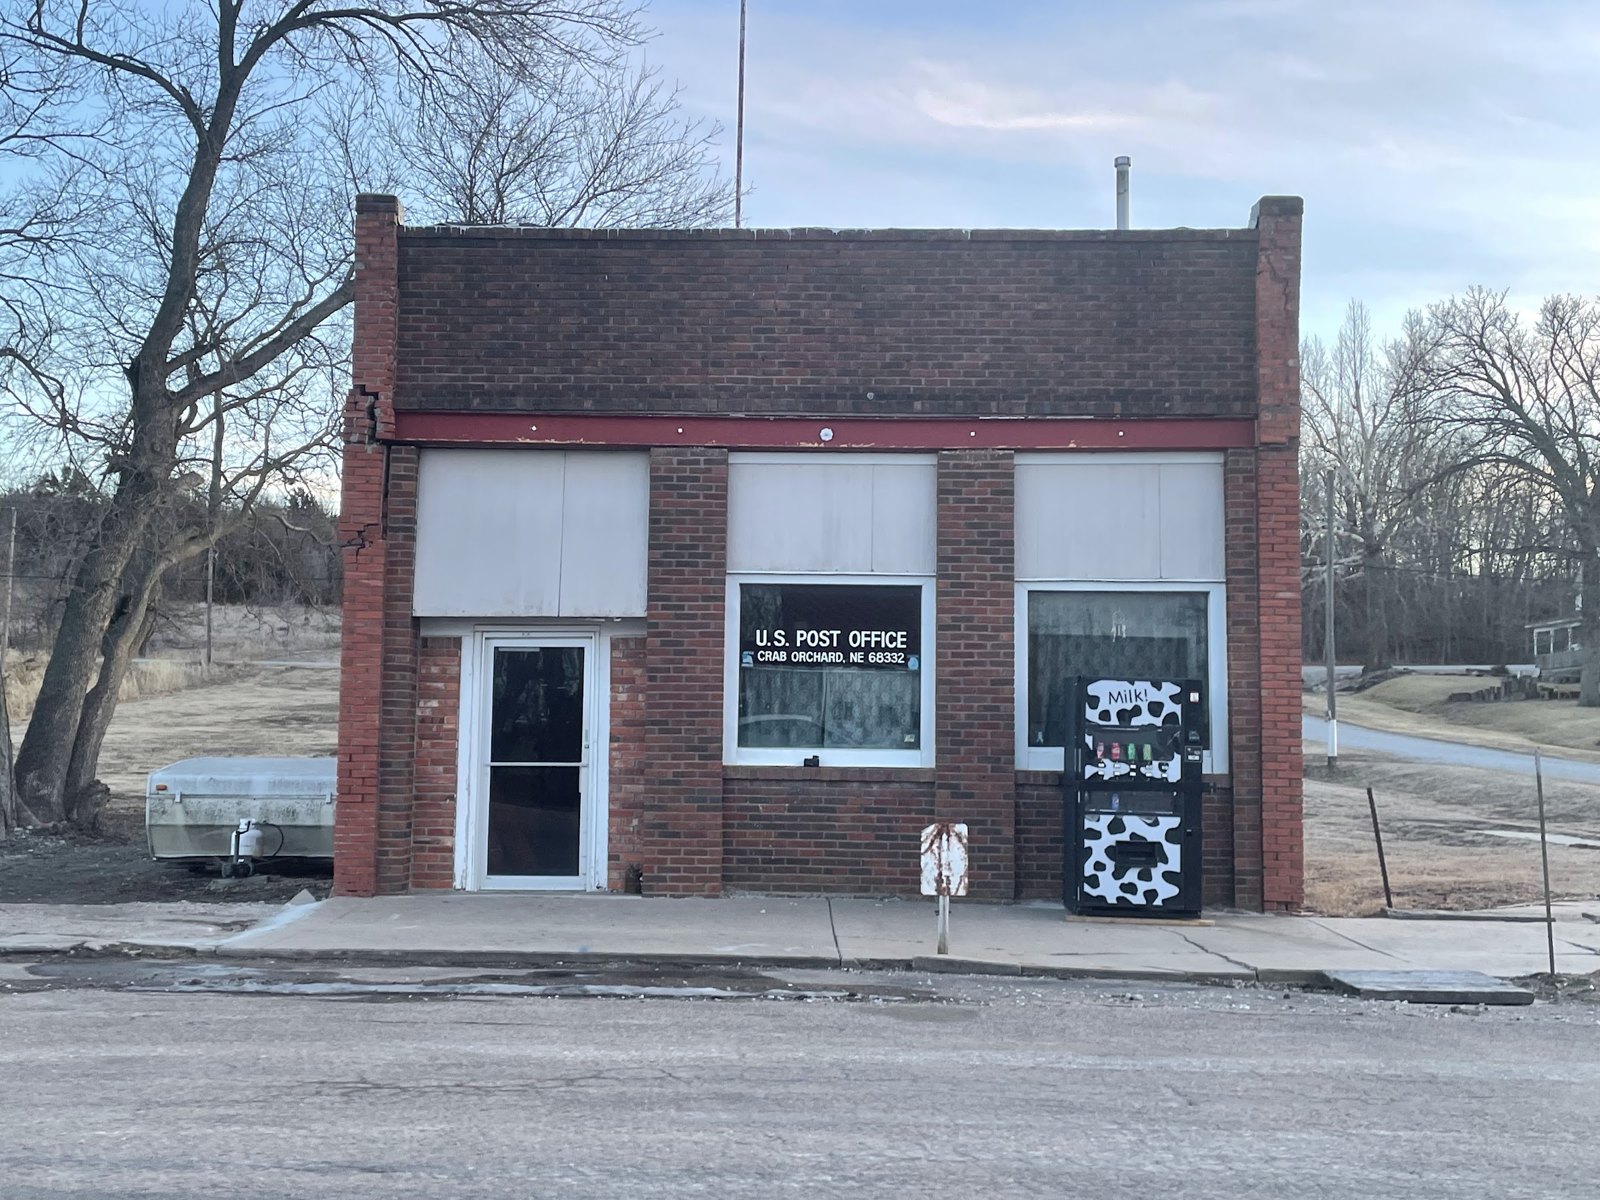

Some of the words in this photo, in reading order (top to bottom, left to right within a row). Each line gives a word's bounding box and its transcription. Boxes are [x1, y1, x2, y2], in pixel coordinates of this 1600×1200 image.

[755, 629, 790, 647] U.S.
[796, 629, 841, 647] POST
[848, 630, 907, 649] OFFICE
[757, 650, 787, 662] CRAB
[850, 652, 865, 663] NE
[868, 652, 905, 664] 68332
[1108, 689, 1148, 704] Milk!
